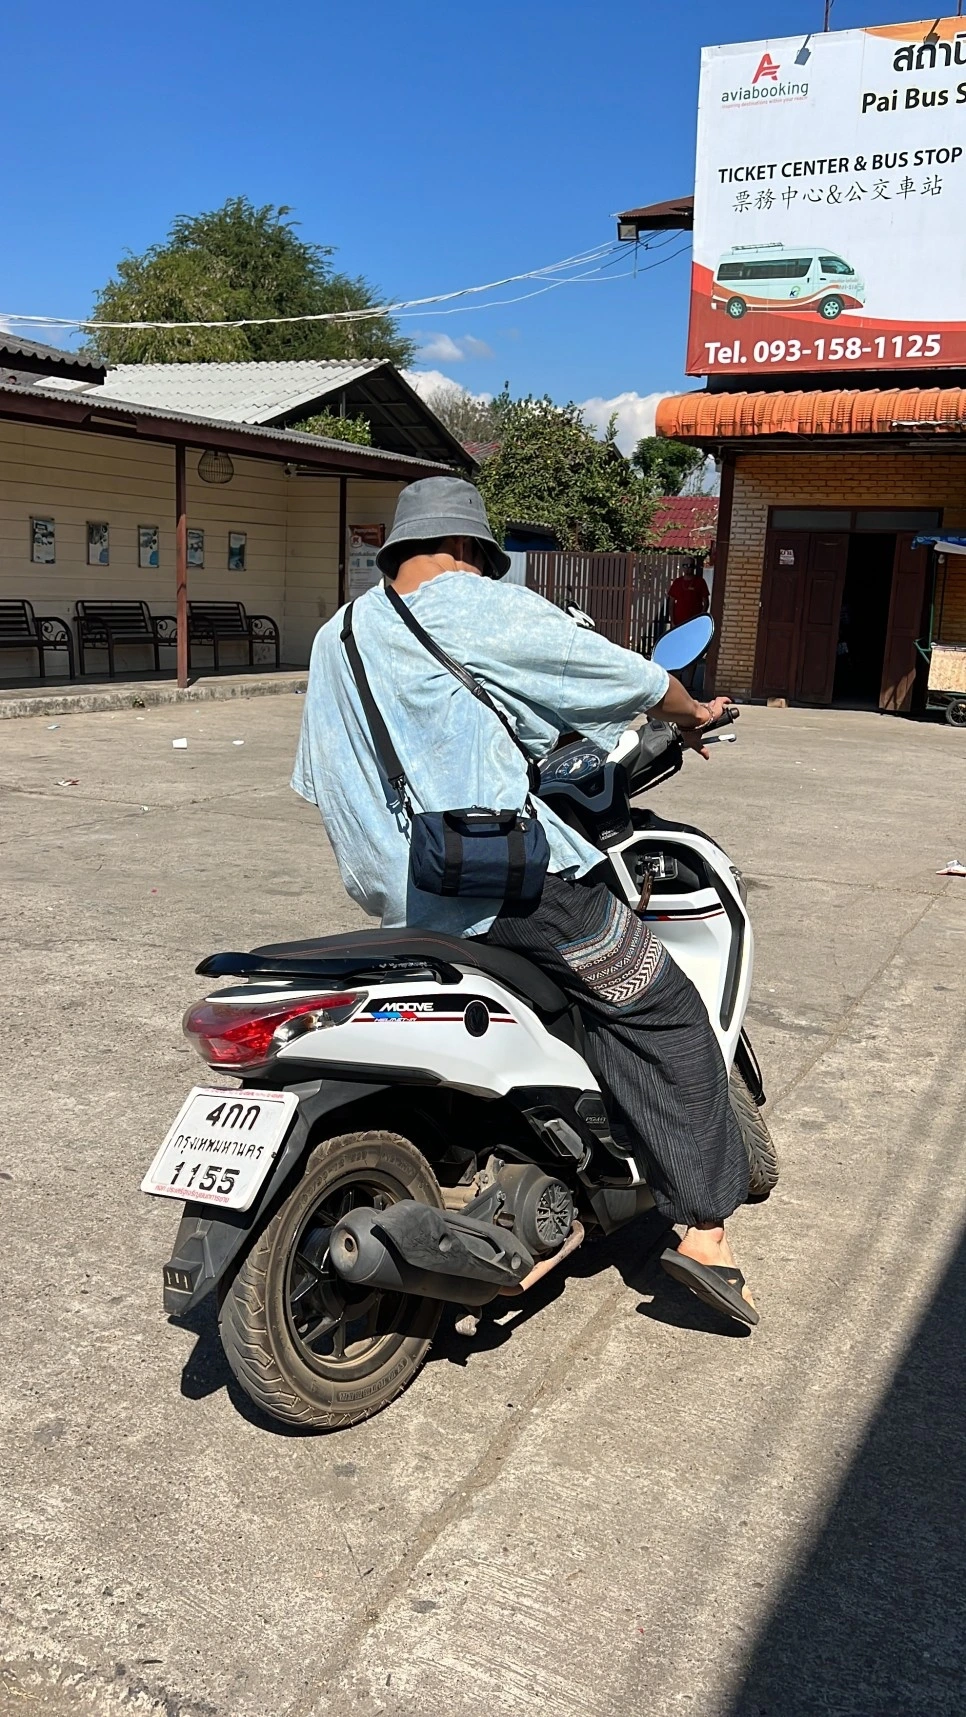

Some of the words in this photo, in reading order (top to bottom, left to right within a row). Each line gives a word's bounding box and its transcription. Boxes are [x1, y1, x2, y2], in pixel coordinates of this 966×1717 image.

[721, 82, 809, 102] aviabooking
[861, 89, 898, 113] Pai
[905, 88, 948, 109] Bus
[718, 164, 777, 184] TICKET
[781, 157, 849, 178] CENTER
[854, 155, 867, 172] &
[872, 152, 908, 170] BUS
[914, 147, 963, 166] STOP
[704, 340, 747, 365] Tel.
[753, 334, 941, 363] 093-158-1125
[379, 1002, 434, 1012] MOOVE
[206, 1102, 261, 1131] 4กก
[174, 1135, 265, 1160] กรุงเทพมหานคร
[170, 1161, 240, 1195] 1155
